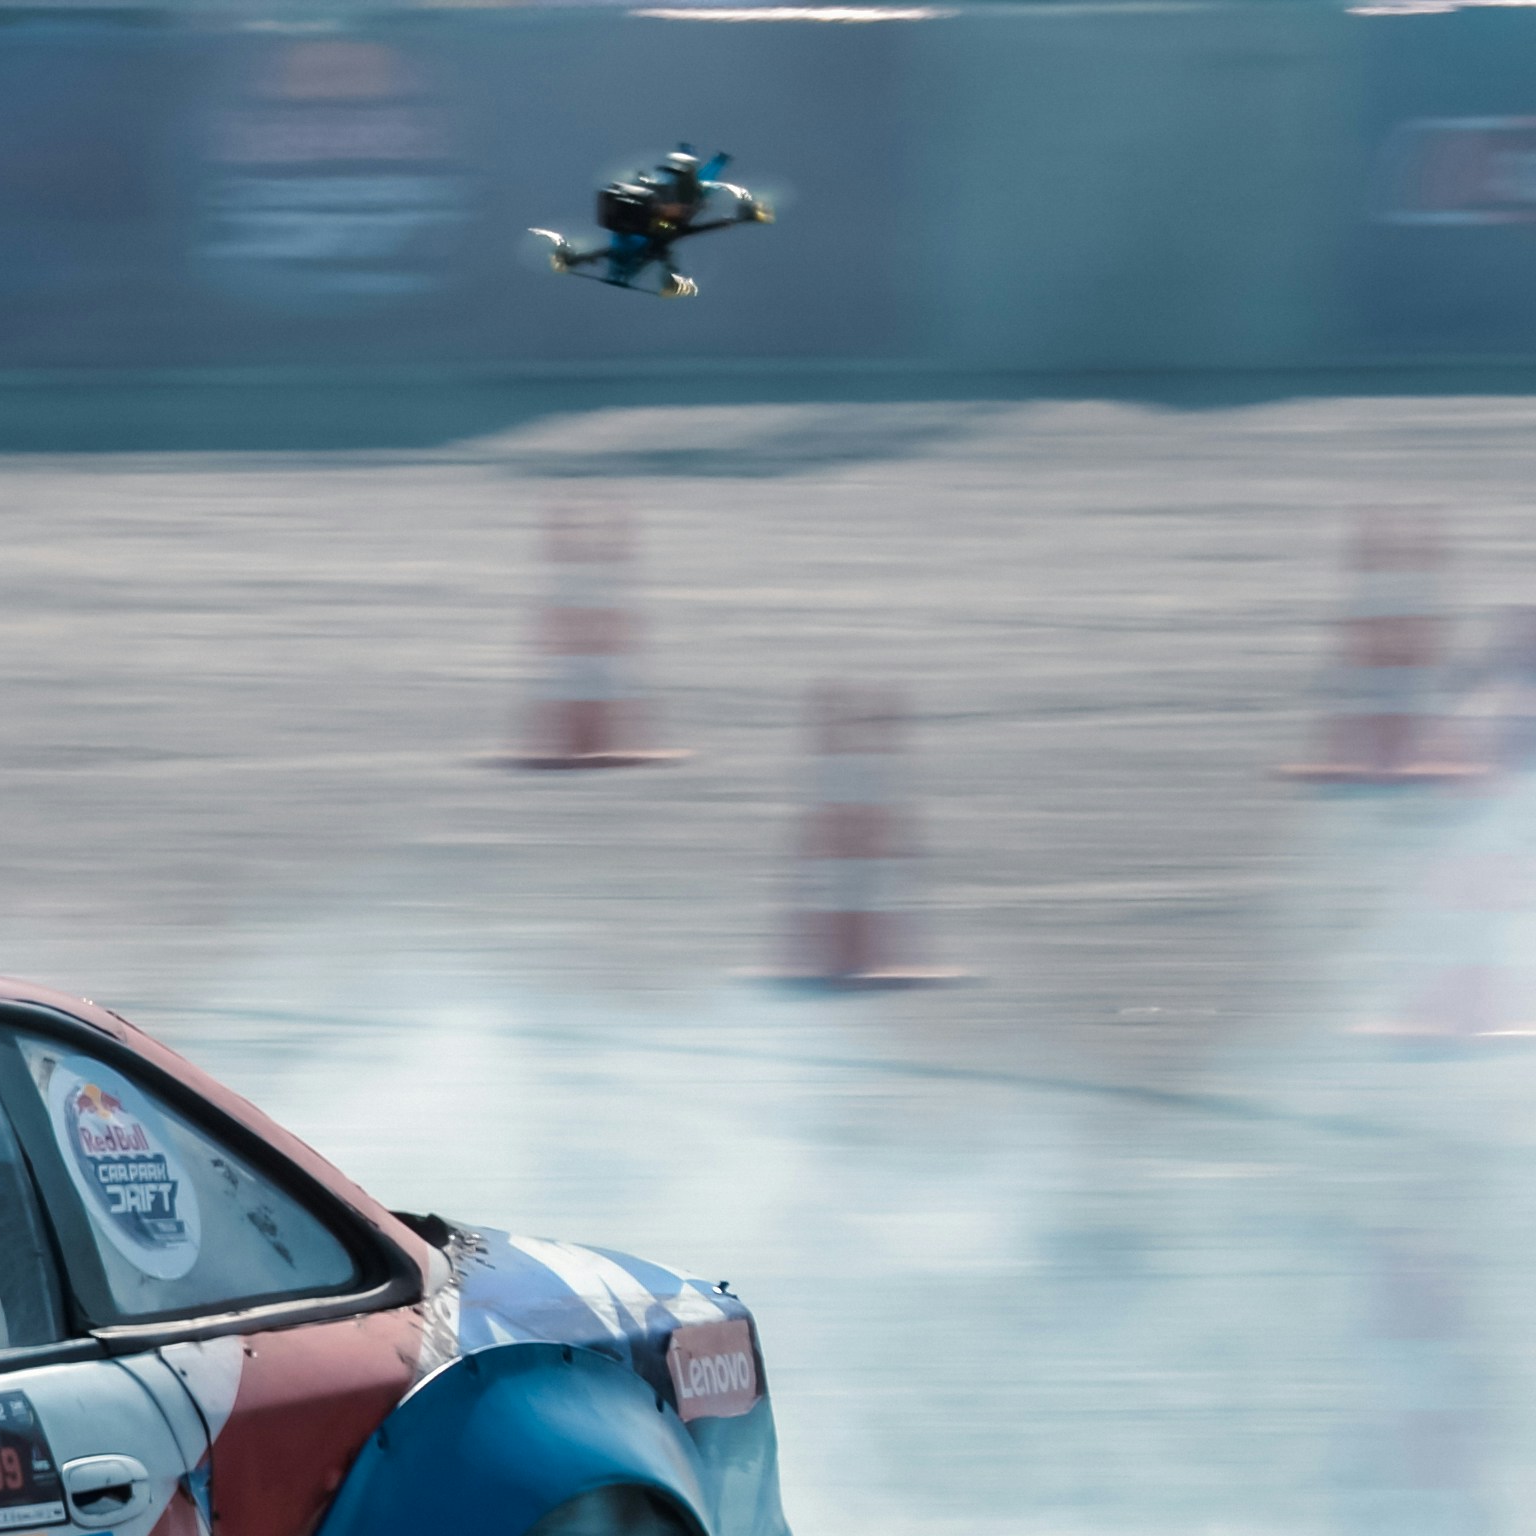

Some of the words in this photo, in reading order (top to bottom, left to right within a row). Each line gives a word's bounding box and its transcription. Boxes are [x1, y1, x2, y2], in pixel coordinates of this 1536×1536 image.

[98, 1162, 129, 1184] CAR
[130, 1161, 169, 1181] PARK
[106, 1182, 174, 1214] DRIFT
[675, 1350, 751, 1399] Lenovo
